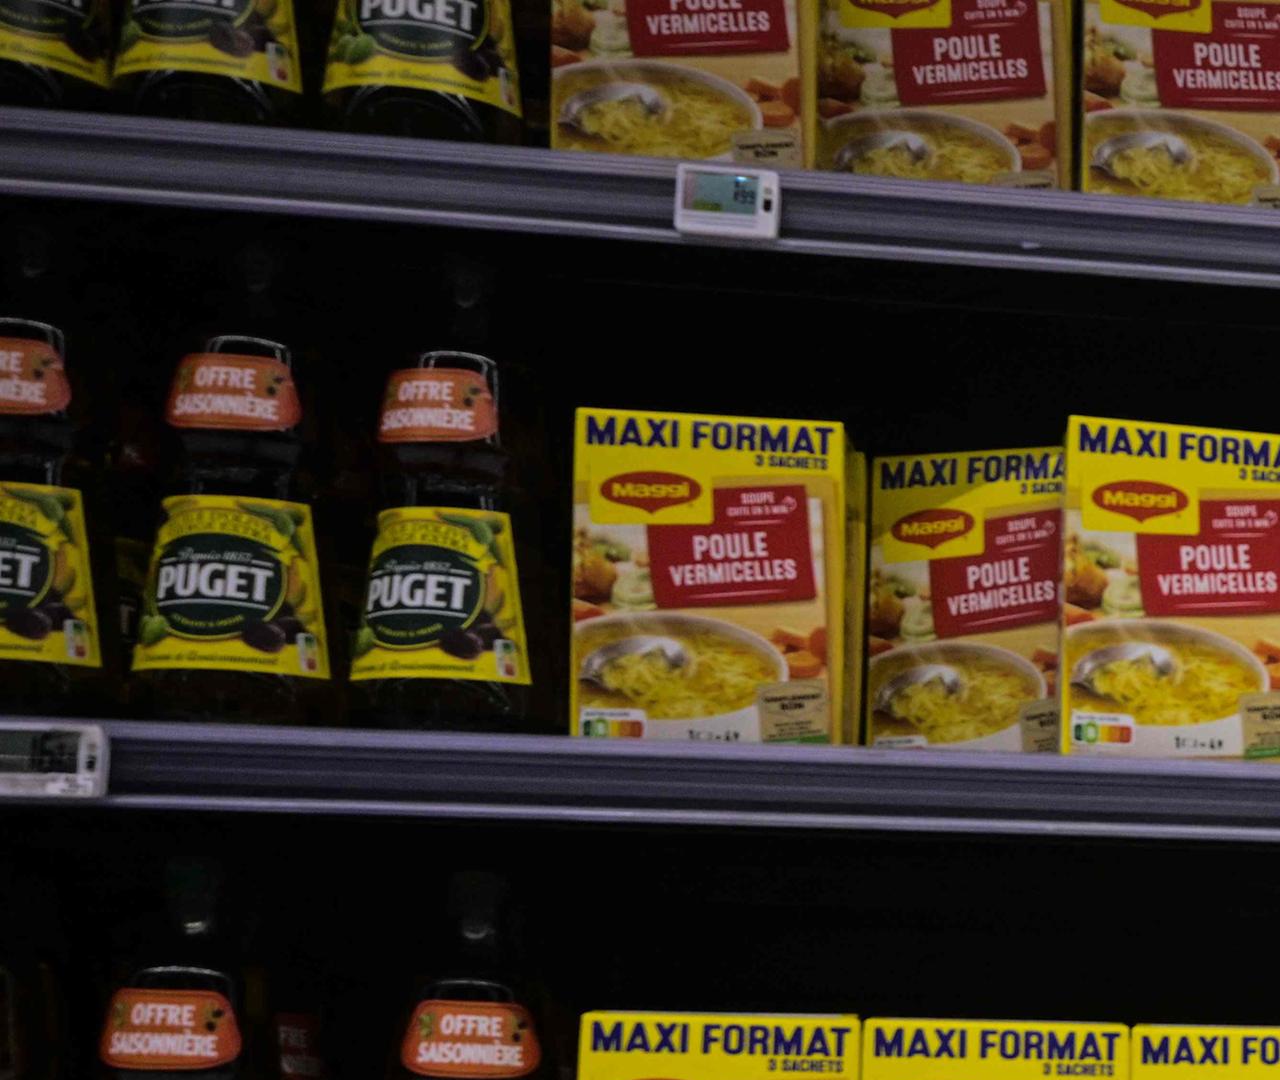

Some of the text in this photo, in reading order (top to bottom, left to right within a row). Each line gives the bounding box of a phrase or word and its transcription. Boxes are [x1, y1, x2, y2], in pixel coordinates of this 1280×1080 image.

[646, 9, 771, 36] VERMICELLES
[932, 34, 1001, 63] POULE
[1193, 42, 1262, 69] POULE
[913, 57, 1029, 86] VERMICELLES
[194, 366, 256, 391] OFFRE
[398, 381, 453, 402] OFFRE
[586, 415, 835, 456] MAXI FORMAT
[1080, 424, 1167, 458] MAXI
[881, 453, 1063, 490] MAXI FORMA
[692, 532, 768, 560] POULE
[1179, 544, 1251, 571] POULE
[156, 562, 275, 603] PUGET
[669, 559, 797, 587] VERMICELLES
[967, 556, 1030, 590] POULE
[1158, 570, 1277, 595] VERMICELLES
[366, 572, 472, 611] PUGET
[948, 579, 1055, 616] VERMICELLES
[130, 1003, 196, 1026] OFFRE
[439, 1015, 503, 1037] OFFRE
[593, 1021, 851, 1057] MAXI FORMAT
[875, 1029, 1121, 1060] MAXI FORMAT
[1141, 1036, 1228, 1064] MAXI
